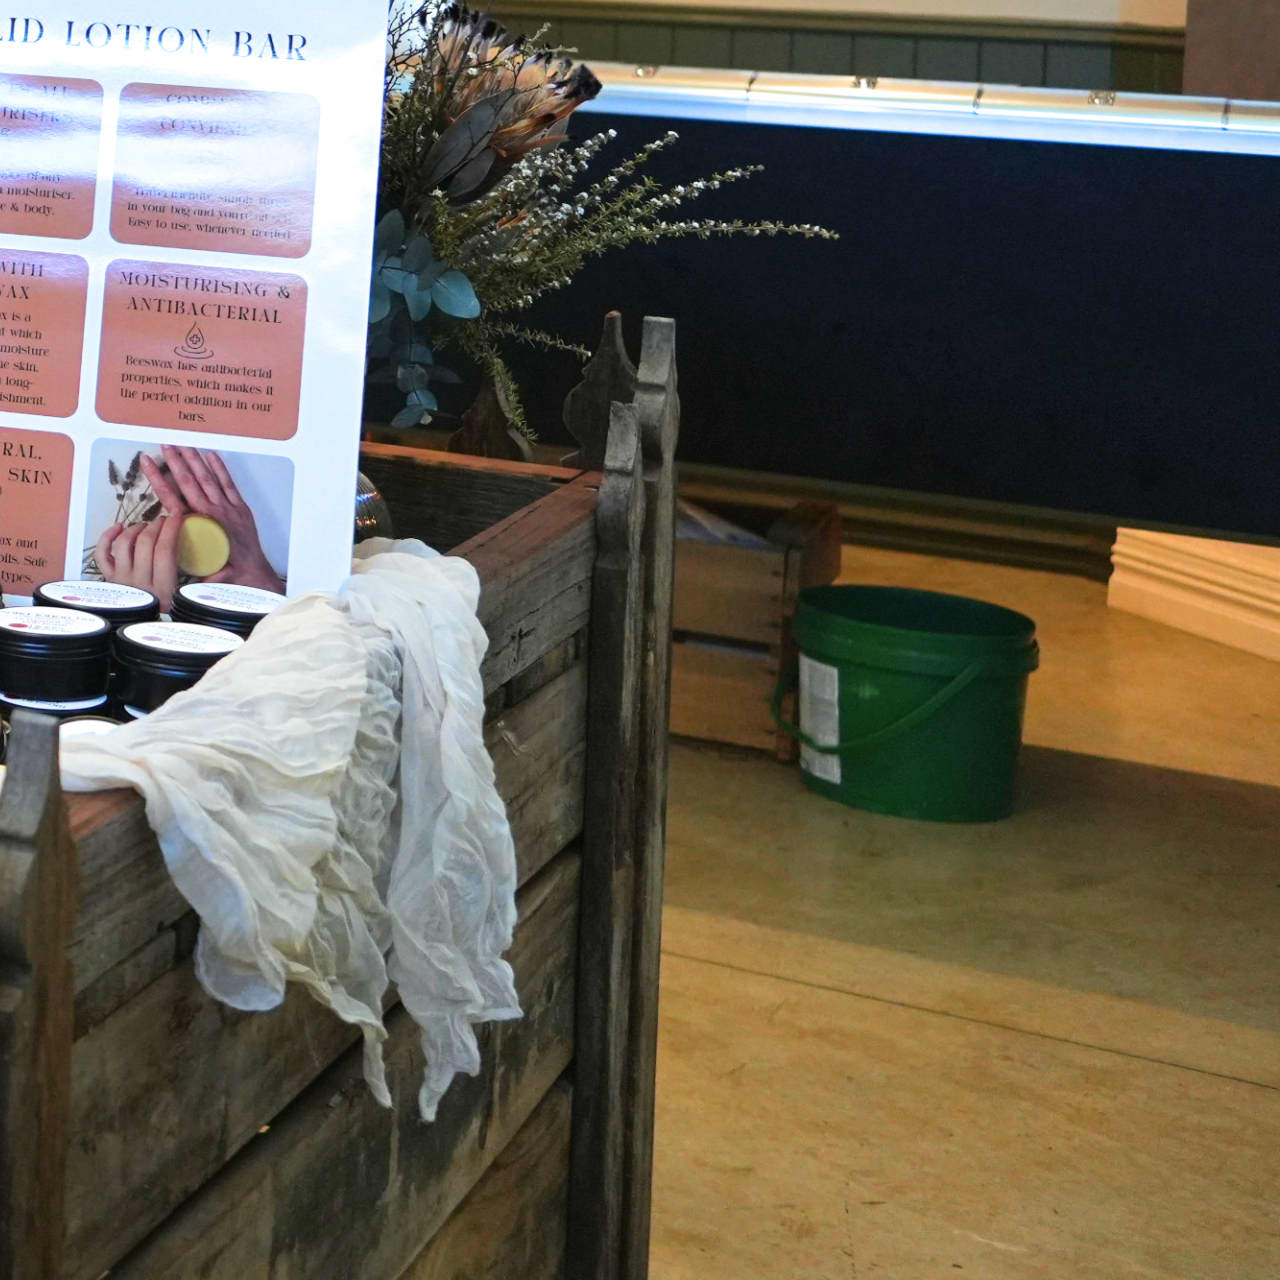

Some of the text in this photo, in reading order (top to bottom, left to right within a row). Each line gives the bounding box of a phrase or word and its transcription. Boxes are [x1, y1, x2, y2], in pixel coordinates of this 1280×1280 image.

[65, 20, 211, 55] LOTION
[232, 31, 308, 61] BAR
[10, 201, 19, 212] &
[120, 271, 290, 299] MOISTURISING &
[127, 296, 282, 323] ANTIBACTERIAL
[8, 466, 52, 485] SKIN
